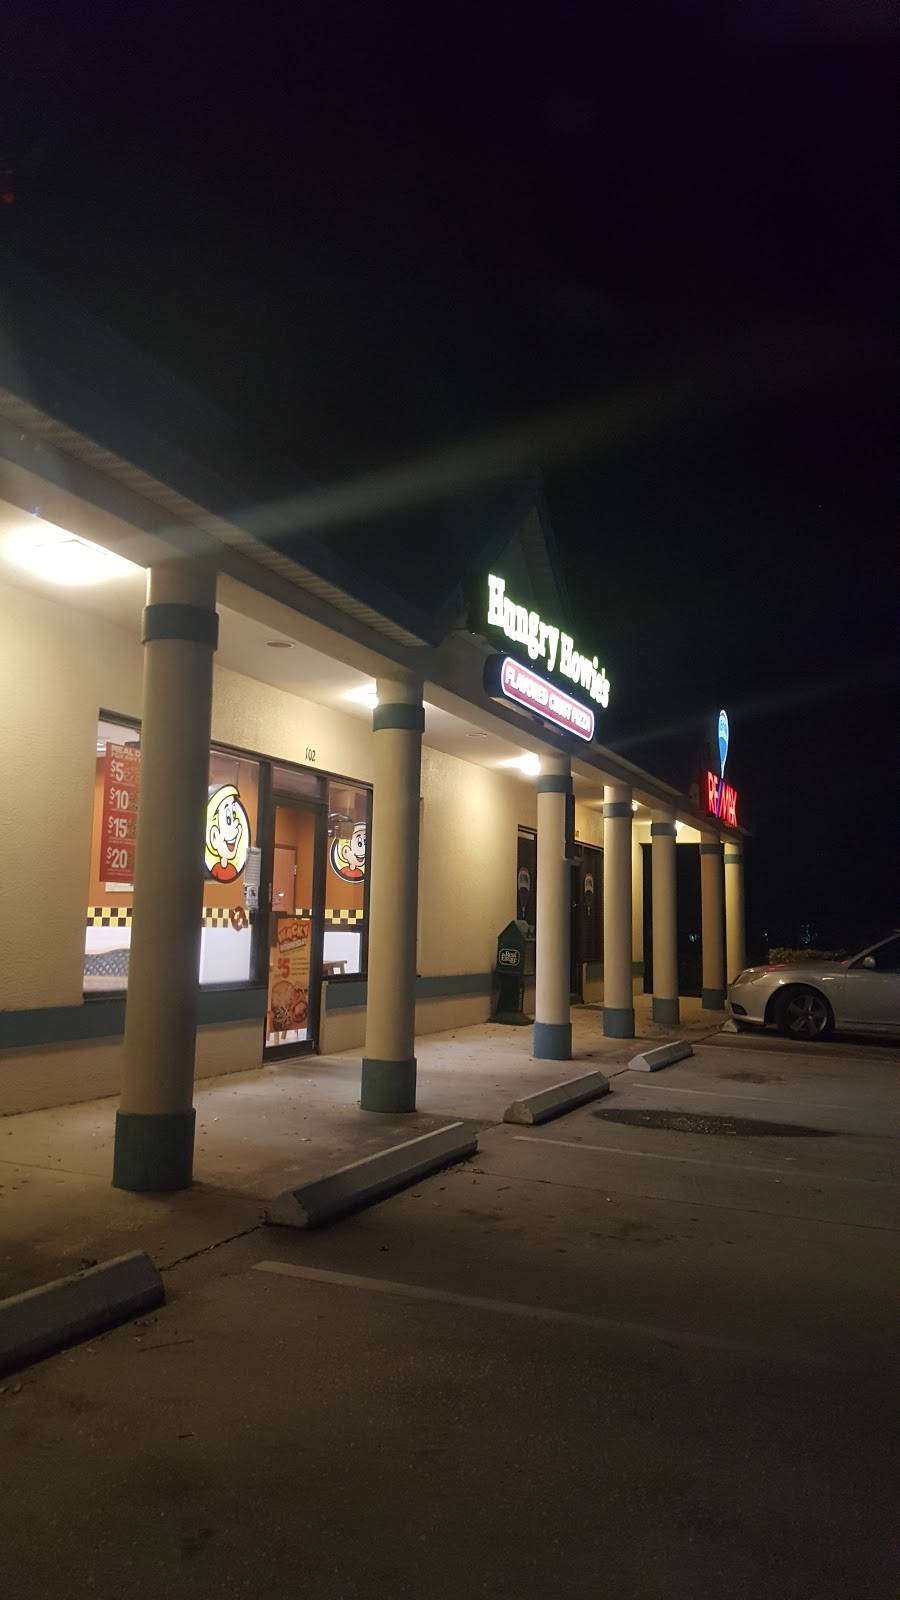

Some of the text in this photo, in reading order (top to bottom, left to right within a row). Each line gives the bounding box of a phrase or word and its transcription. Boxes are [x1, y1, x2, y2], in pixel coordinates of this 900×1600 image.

[488, 574, 610, 708] Hungry Howie's
[305, 747, 315, 761] 102
[111, 760, 124, 781] $5
[110, 787, 129, 809] $10
[707, 771, 738, 827] RE/MAX
[107, 815, 128, 838] $15
[106, 847, 128, 869] $20
